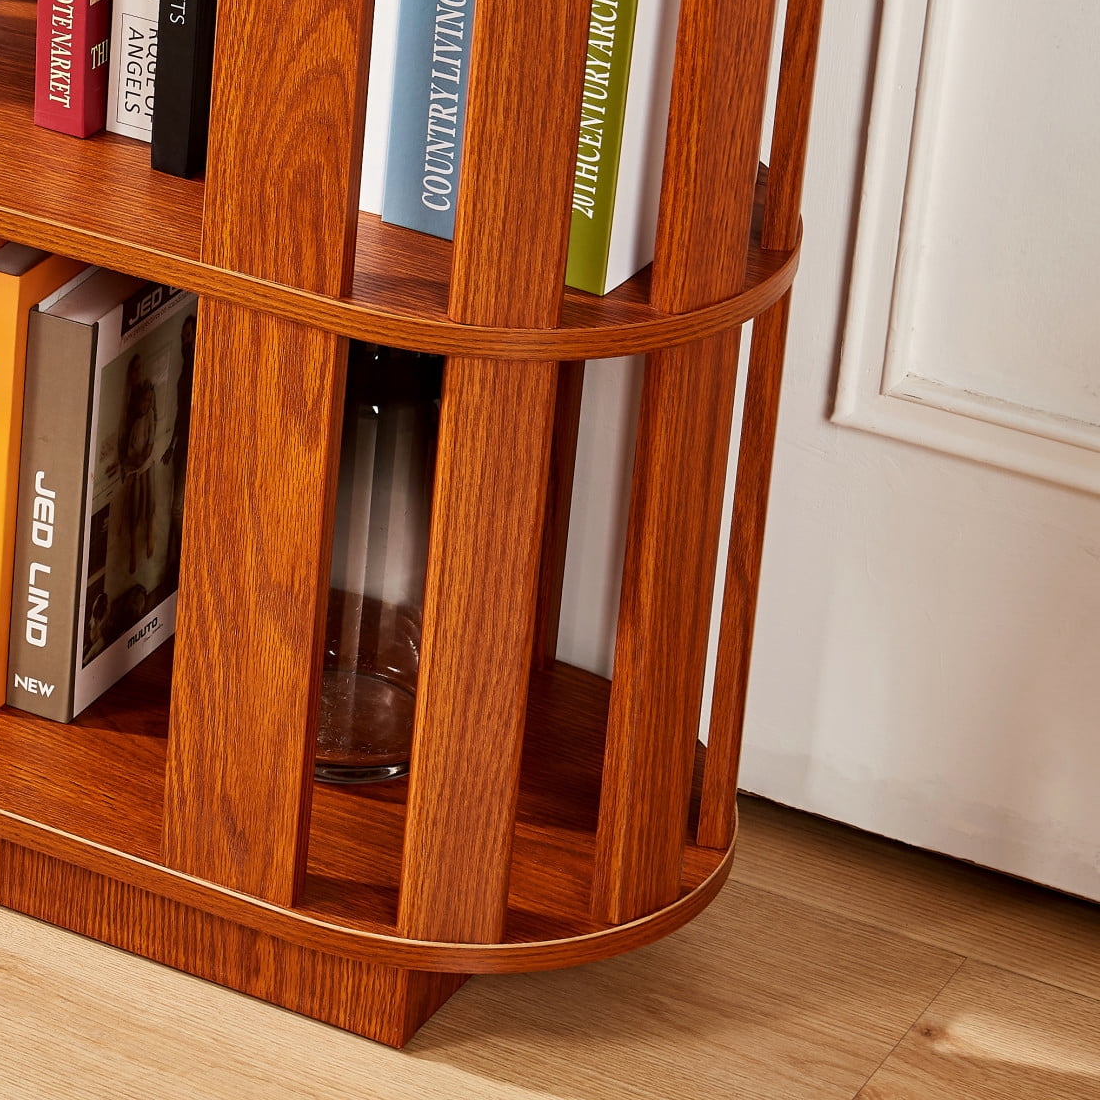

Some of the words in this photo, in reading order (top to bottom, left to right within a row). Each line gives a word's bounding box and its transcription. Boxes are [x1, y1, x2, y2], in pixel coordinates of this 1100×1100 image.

[125, 26, 144, 114] ANGELS
[422, 83, 461, 212] COUNTRY
[32, 470, 56, 548] JED
[25, 562, 51, 648] LIND
[14, 673, 55, 698] NEW
